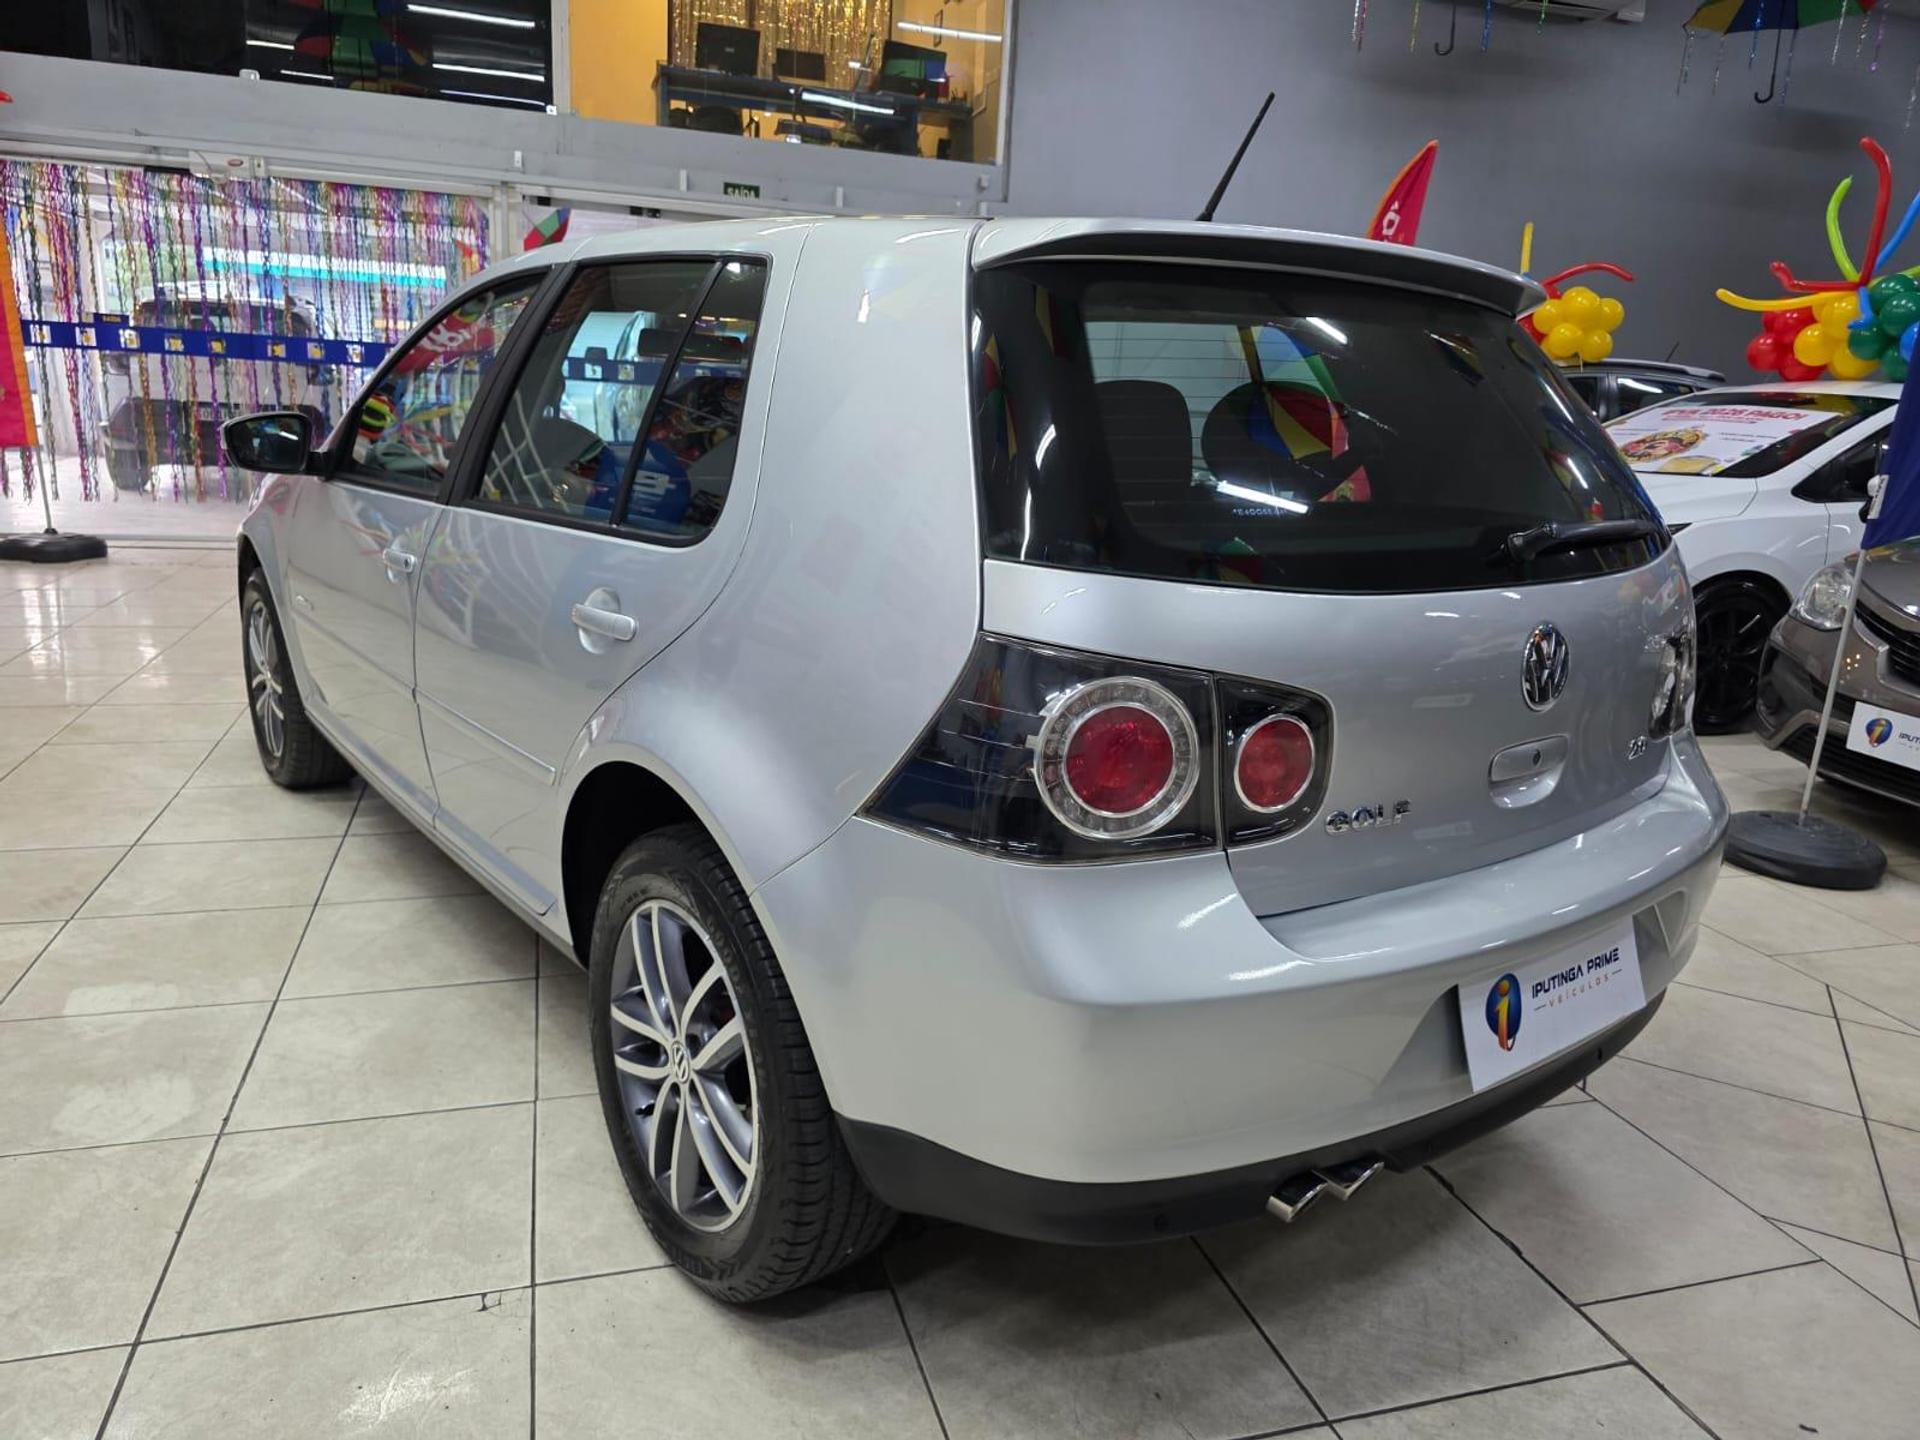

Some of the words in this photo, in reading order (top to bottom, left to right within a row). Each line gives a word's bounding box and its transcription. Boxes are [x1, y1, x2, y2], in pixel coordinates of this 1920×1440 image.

[1326, 799, 1411, 834] GOLF
[1531, 964, 1583, 999] IPUTINGA
[1587, 948, 1620, 974] PRIME
